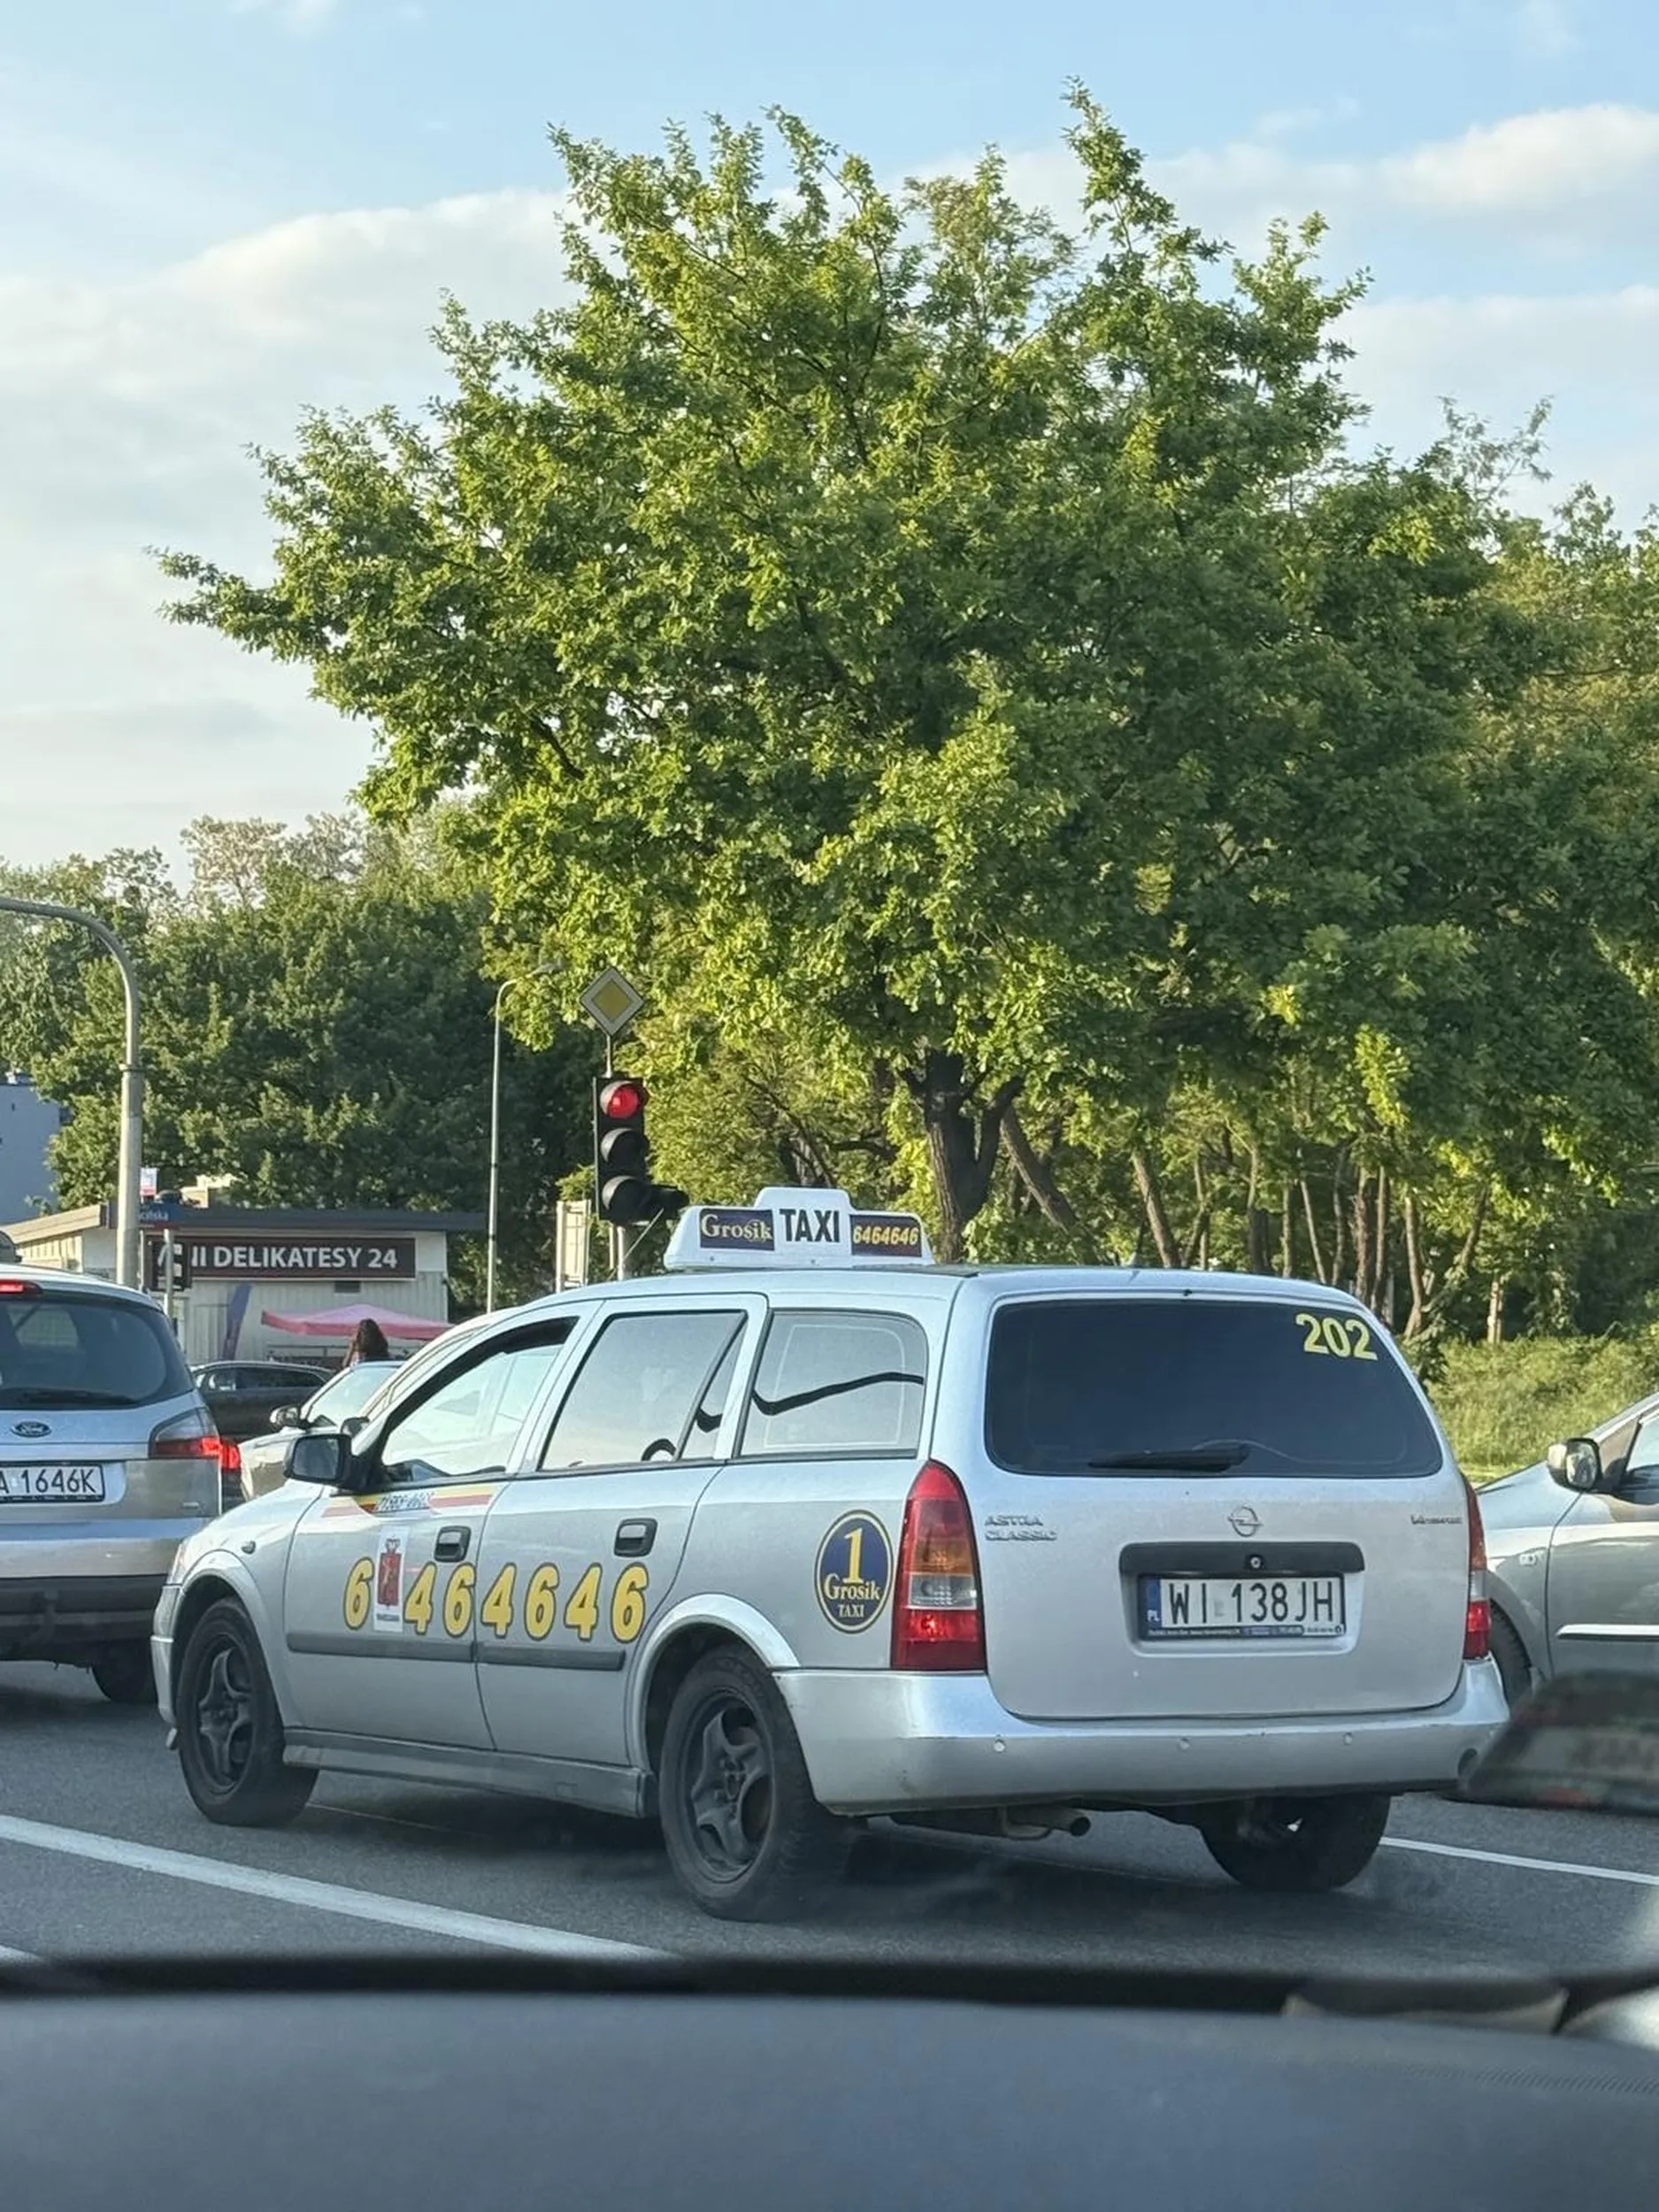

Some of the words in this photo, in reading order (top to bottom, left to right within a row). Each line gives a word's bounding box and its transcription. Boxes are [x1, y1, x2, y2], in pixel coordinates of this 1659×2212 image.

[700, 1214, 772, 1241] Grosik
[780, 1209, 840, 1242] TAXI
[853, 1225, 919, 1245] 6464646
[213, 1246, 363, 1269] DELIKATESY
[367, 1248, 398, 1269] 24
[1295, 1313, 1378, 1361] 202
[21, 1469, 96, 1494] 1646K
[844, 1527, 864, 1584] 1
[824, 1573, 880, 1601] Grosik
[838, 1604, 865, 1617] TAXI
[1169, 1582, 1207, 1624] WI
[1232, 1580, 1333, 1623] 138JH
